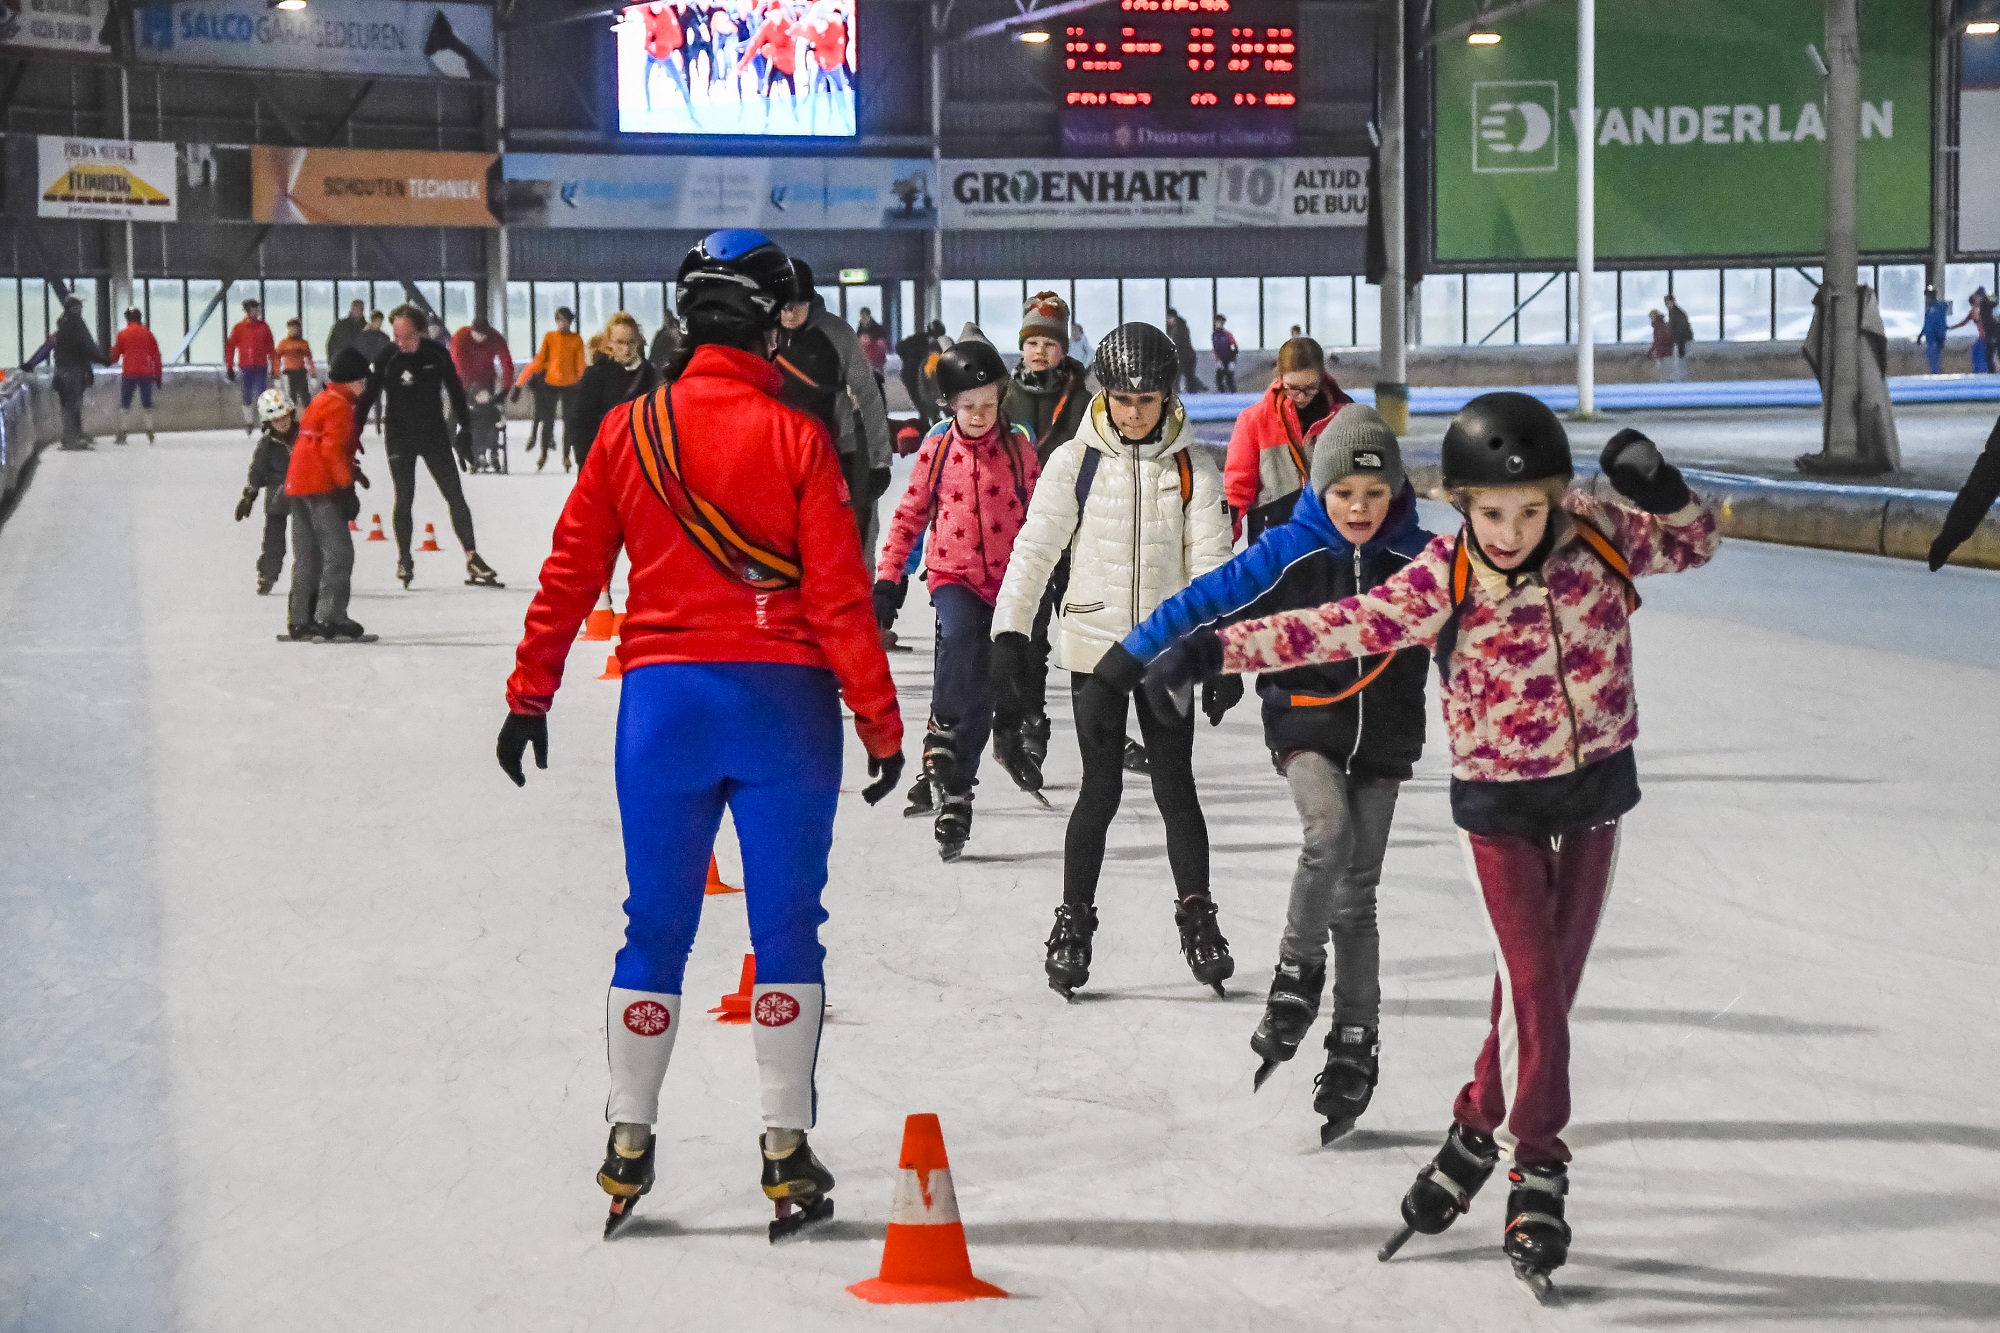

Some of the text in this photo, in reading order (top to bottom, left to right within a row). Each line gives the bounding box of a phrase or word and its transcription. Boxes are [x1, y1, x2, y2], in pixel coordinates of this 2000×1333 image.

[180, 10, 406, 50] SALCO GARAGEDEUREN
[1569, 100, 1893, 146] VANDERLAN
[409, 178, 480, 199] TECHNIEK
[953, 170, 1207, 204] GROENHART
[1226, 164, 1275, 206] 10
[1294, 169, 1361, 189] ALTIJD
[1294, 195, 1368, 215] DE BUU
